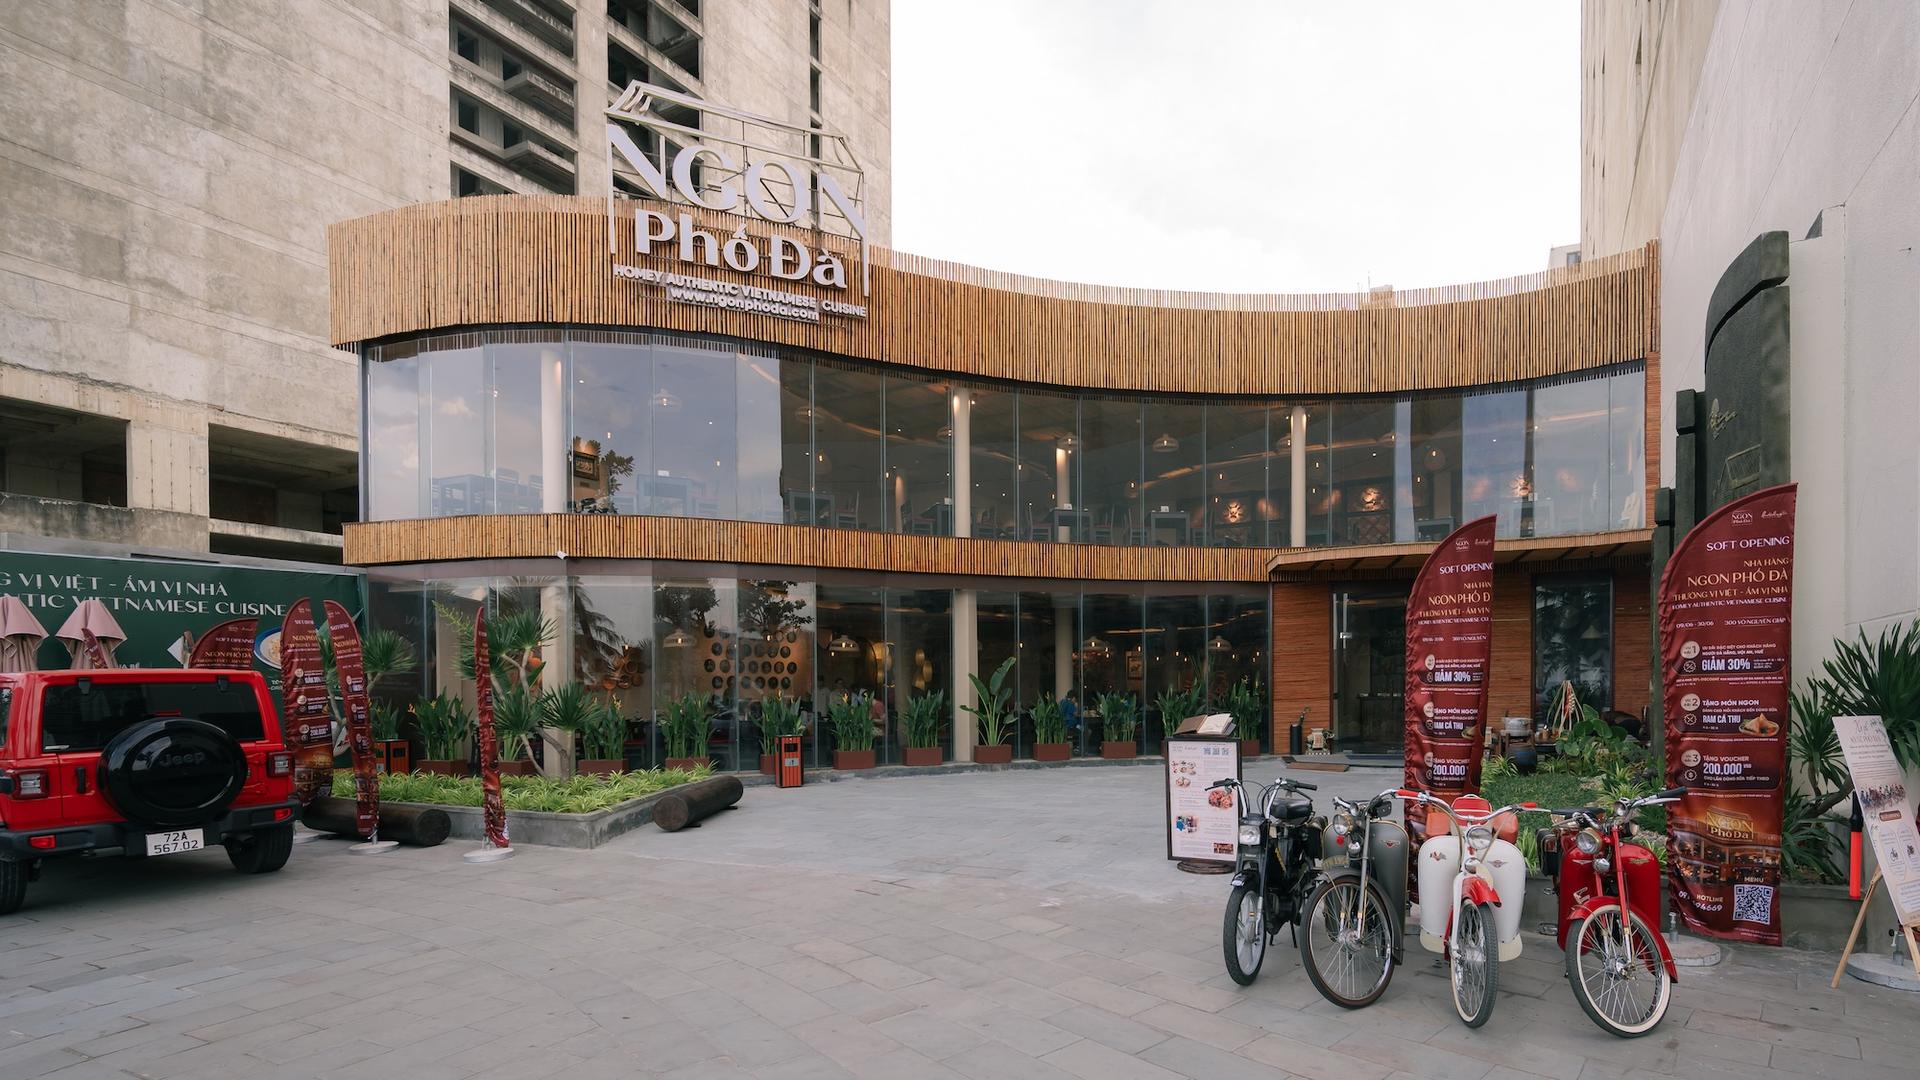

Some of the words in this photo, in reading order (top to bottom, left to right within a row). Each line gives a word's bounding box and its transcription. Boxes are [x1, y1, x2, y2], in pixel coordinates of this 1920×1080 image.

[606, 123, 869, 254] NGON
[613, 264, 662, 283] HOMEY
[666, 273, 739, 297] AUTHENTIC
[741, 285, 817, 309] VIETNAMESE
[822, 300, 867, 317] CUISINE
[670, 288, 819, 321] www.ngonphoda.com
[1706, 540, 1737, 552] SOFT
[1740, 536, 1790, 549] OPENING
[1440, 564, 1460, 575] SOFT
[1688, 574, 1730, 587] NGON
[1732, 568, 1765, 584] PHỐ
[1769, 568, 1788, 580] ĐÀ
[18, 573, 42, 590] VỊ
[48, 574, 103, 592] VIỆT
[161, 580, 182, 596] VỊ
[186, 582, 228, 596] NHÀ
[72, 595, 209, 614] VTNAMESE
[214, 600, 287, 616] CUISINE
[1428, 594, 1456, 606] NGON
[1702, 656, 1726, 671] GIẢM
[1728, 658, 1750, 670] 30%
[1717, 714, 1726, 724] CÁ
[1728, 714, 1740, 724] THU
[160, 751, 207, 768] Jeep
[1703, 763, 1742, 774] 200.000
[1706, 811, 1754, 834] NGON
[164, 832, 188, 842] 72A
[154, 840, 198, 854] 567.02
[1696, 894, 1724, 902] HOTLINE
